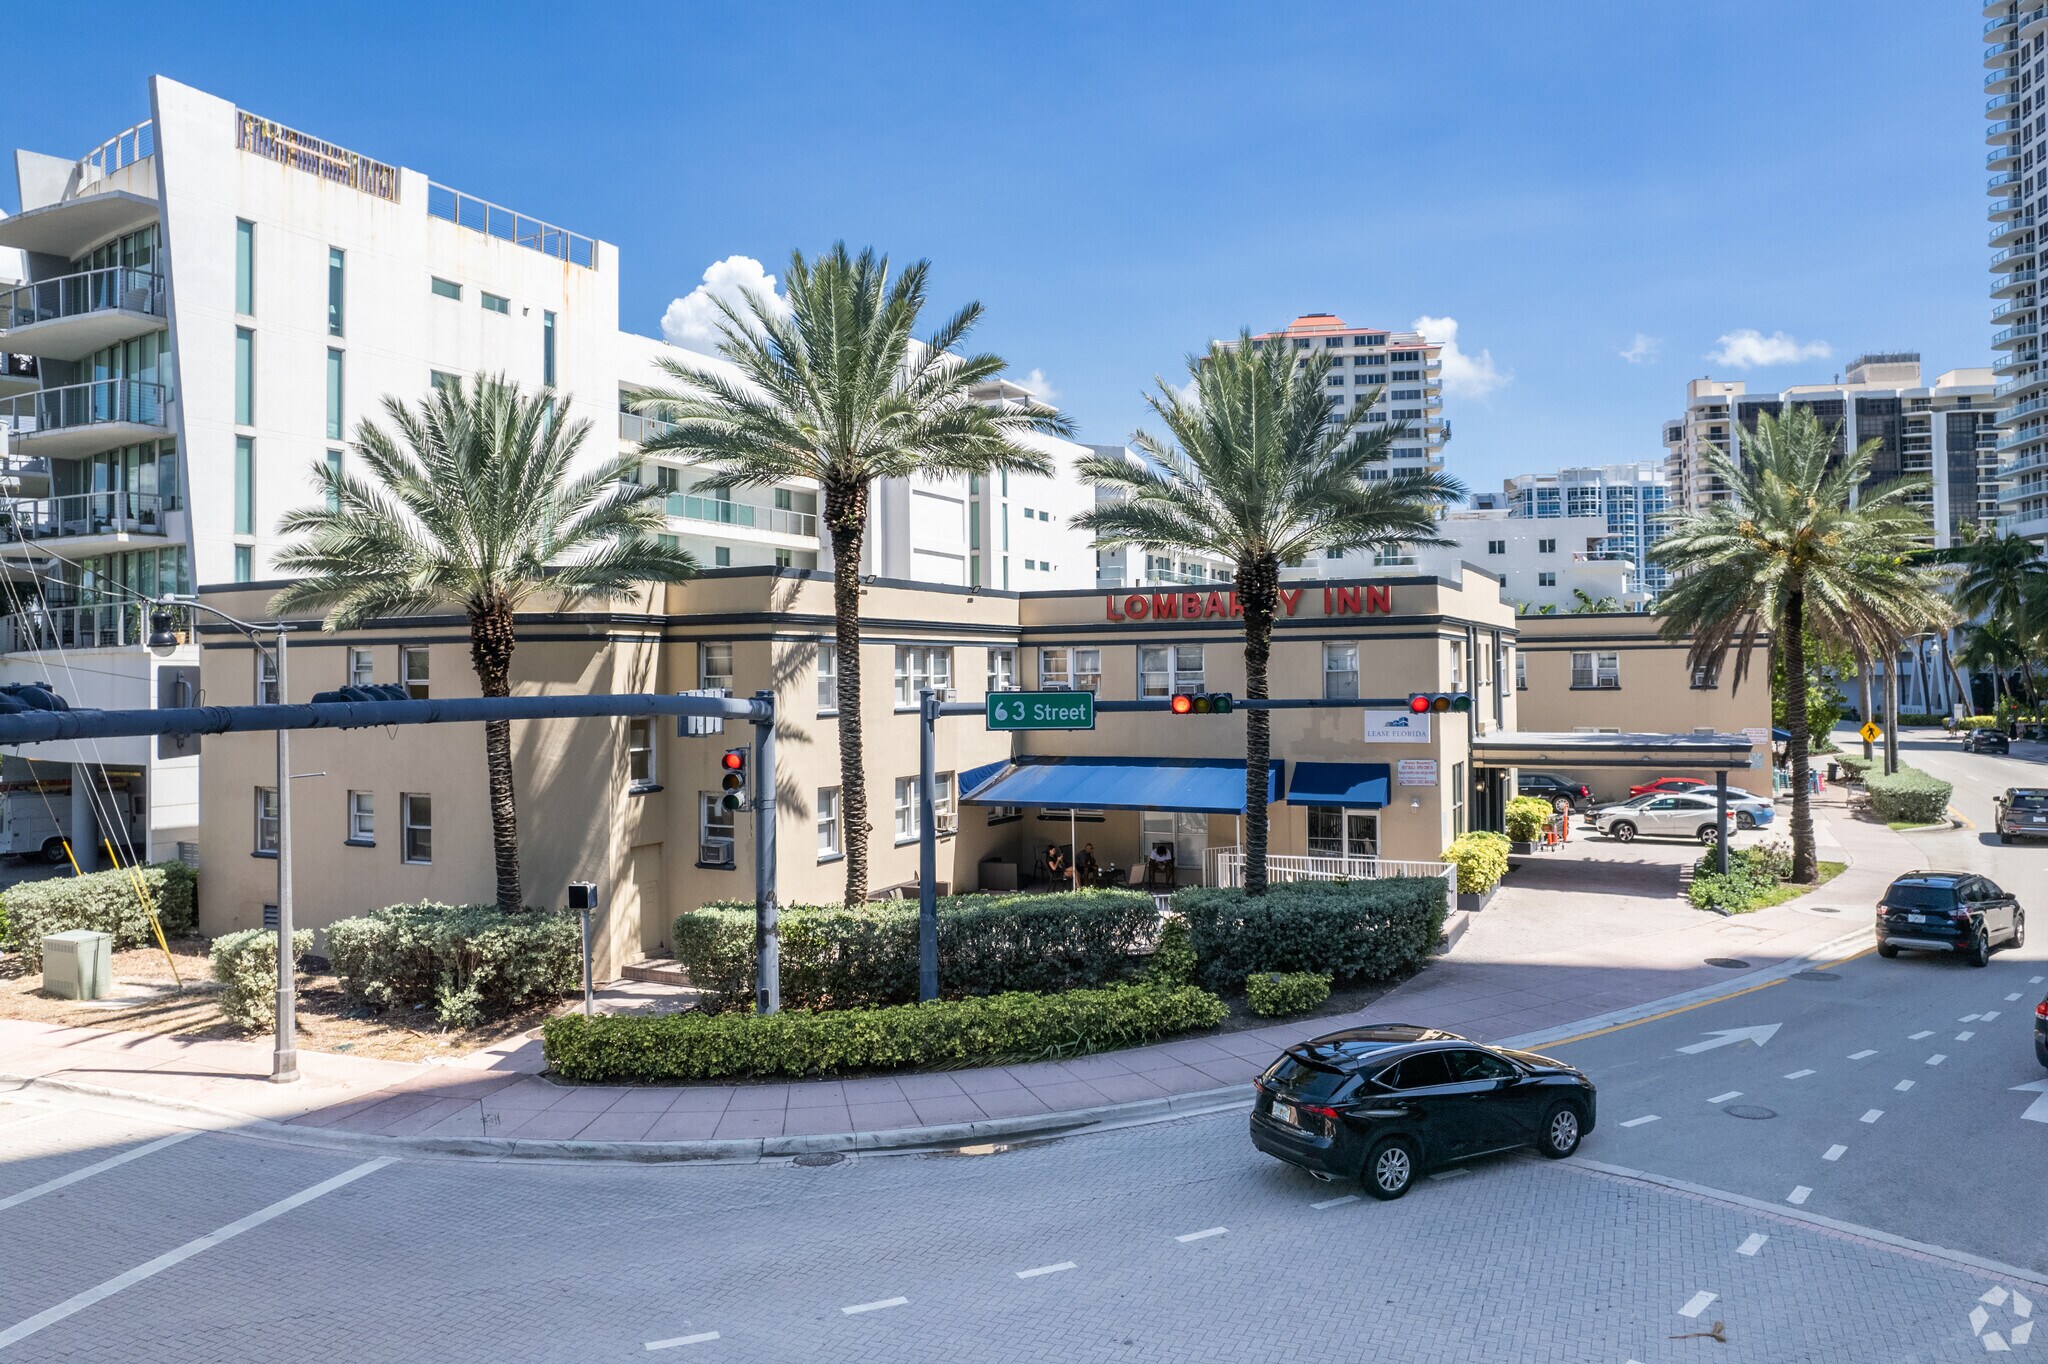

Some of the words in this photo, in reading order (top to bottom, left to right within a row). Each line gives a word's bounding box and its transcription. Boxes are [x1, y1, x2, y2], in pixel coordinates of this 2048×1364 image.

[1107, 590, 1303, 620] LOMBARY
[1324, 585, 1393, 615] INN
[995, 701, 1025, 721] 63
[1034, 704, 1086, 720] Street
